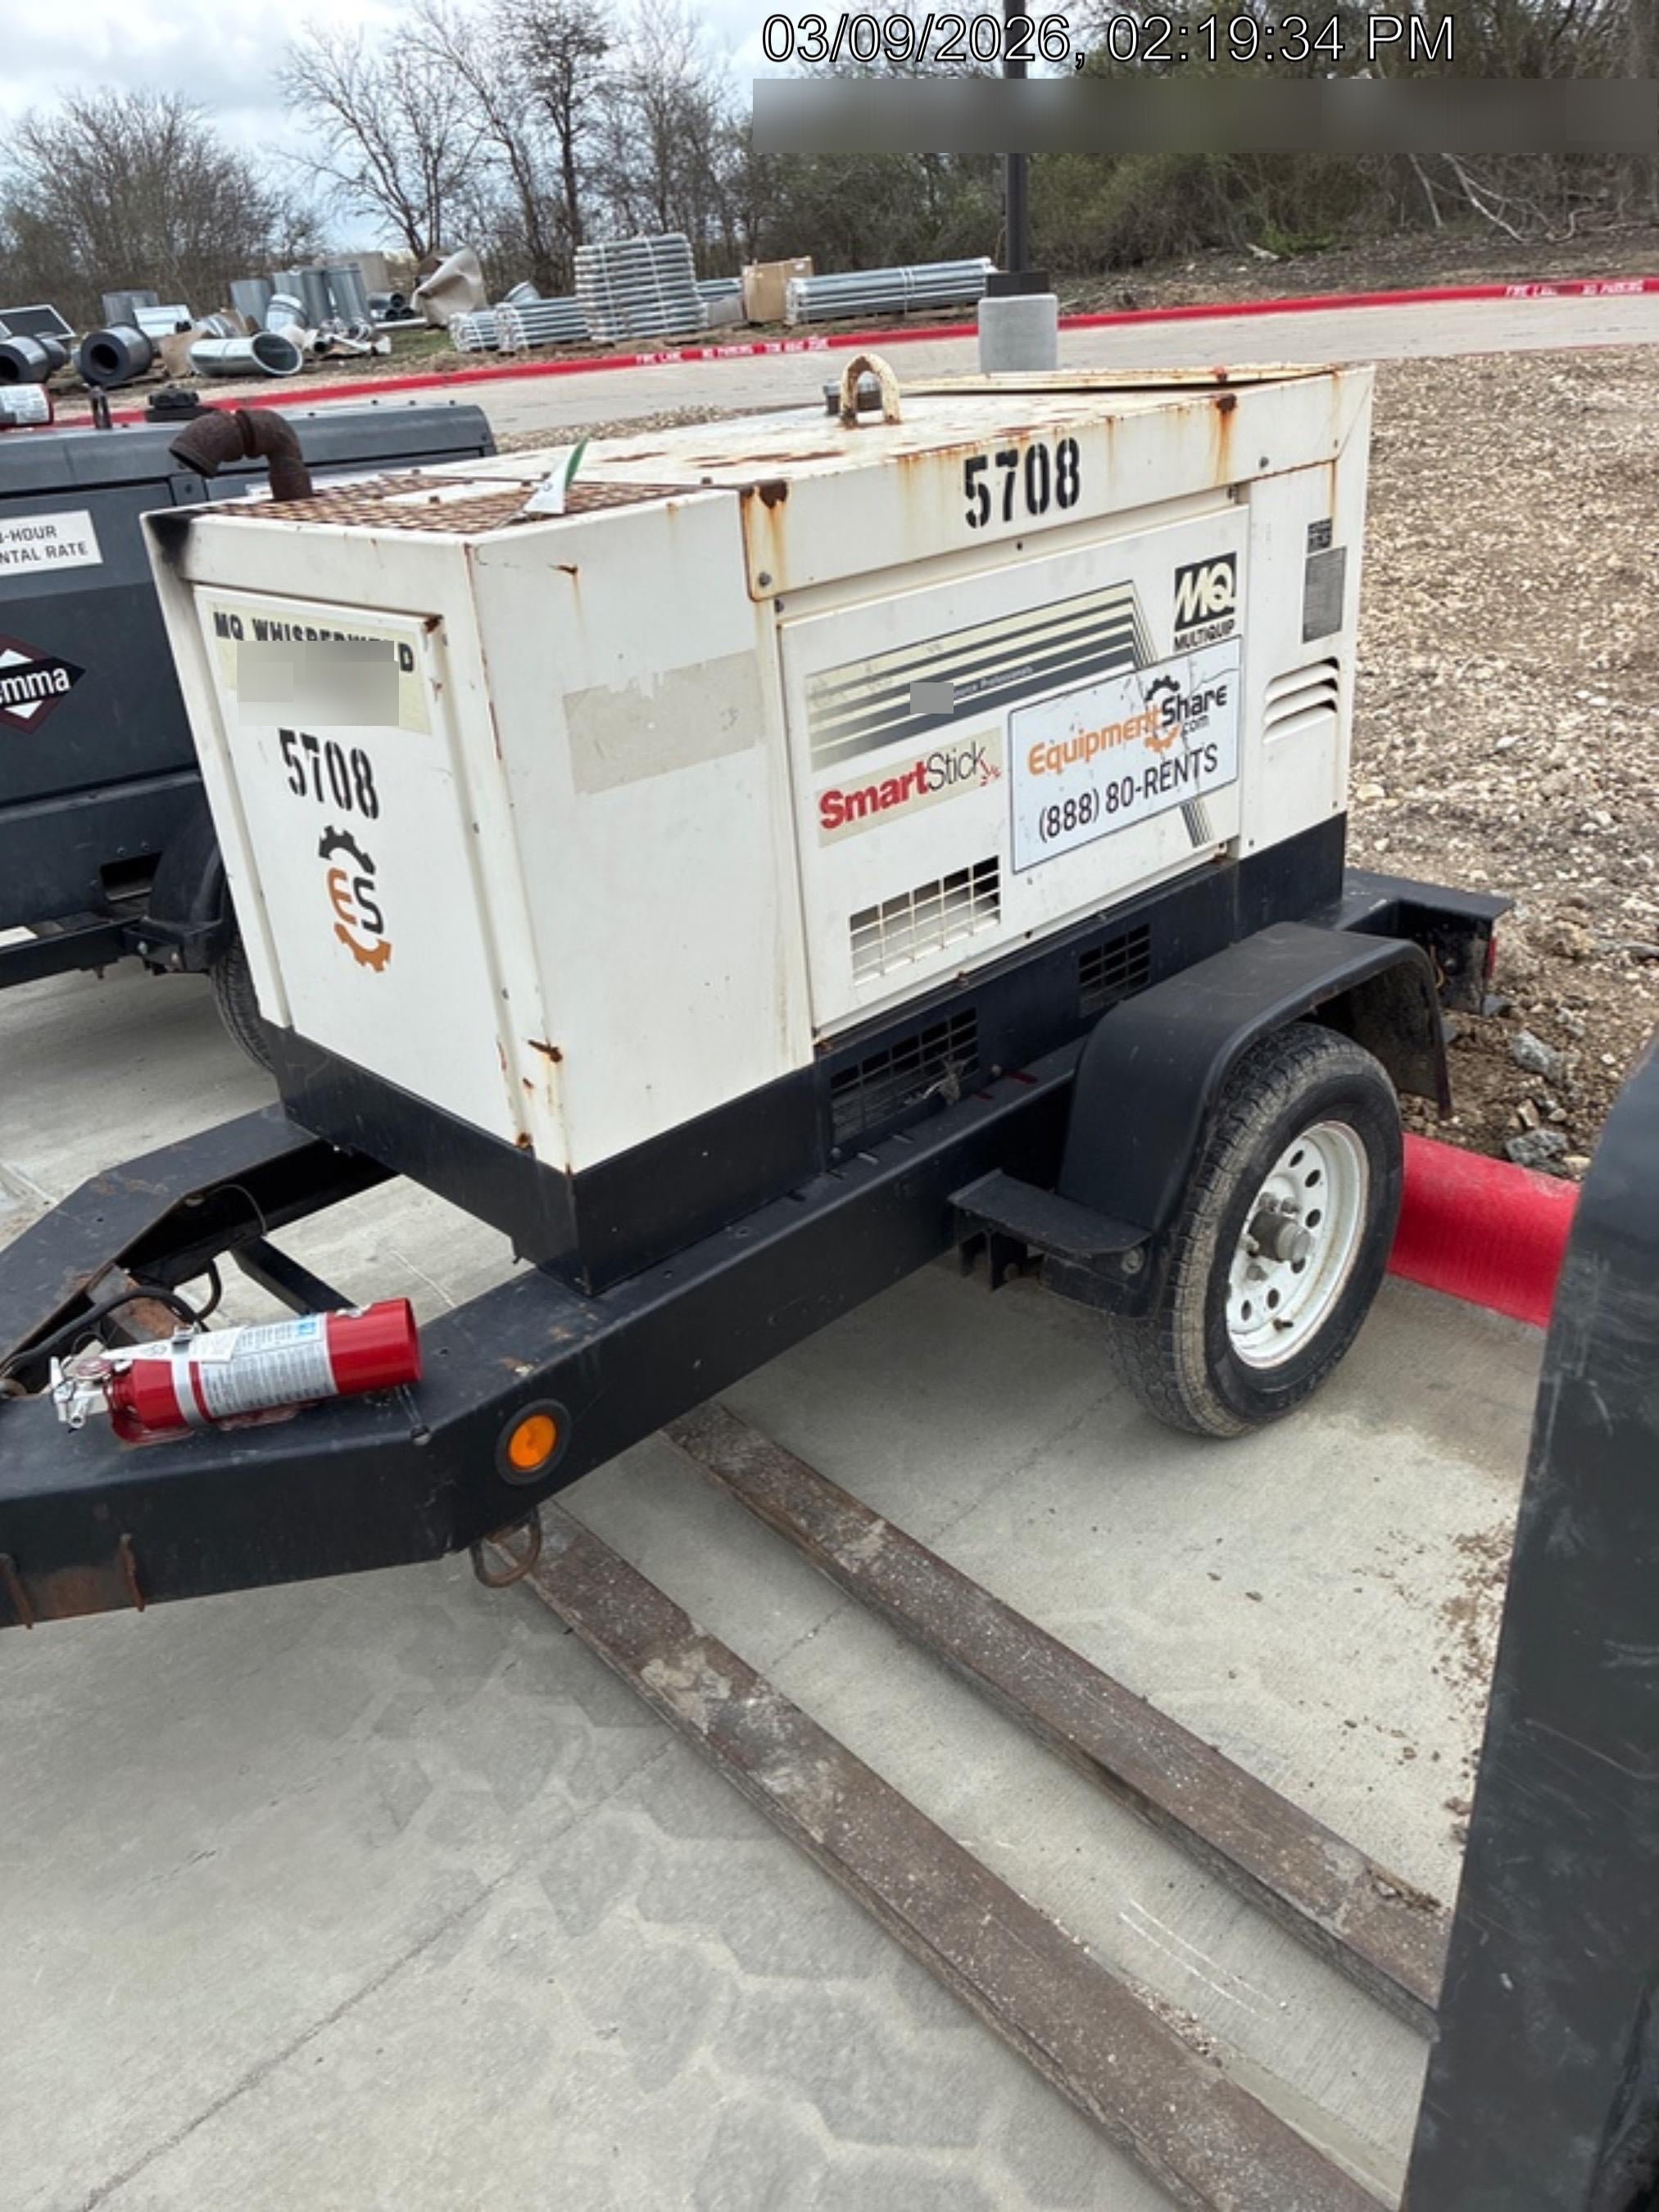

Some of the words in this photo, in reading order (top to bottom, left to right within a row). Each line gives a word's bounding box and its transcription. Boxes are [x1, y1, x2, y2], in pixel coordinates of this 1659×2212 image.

[964, 437, 1081, 529] 5708
[46, 542, 88, 558] RATE
[1174, 562, 1236, 623] MQ
[214, 611, 245, 641] MQ
[1173, 618, 1235, 651] MULTIQUIP
[0, 667, 71, 705] mma
[278, 727, 380, 821] 5708
[820, 741, 986, 830] SmartStick
[1038, 787, 1099, 844] (888)
[1105, 742, 1218, 814] 80-RENTS
